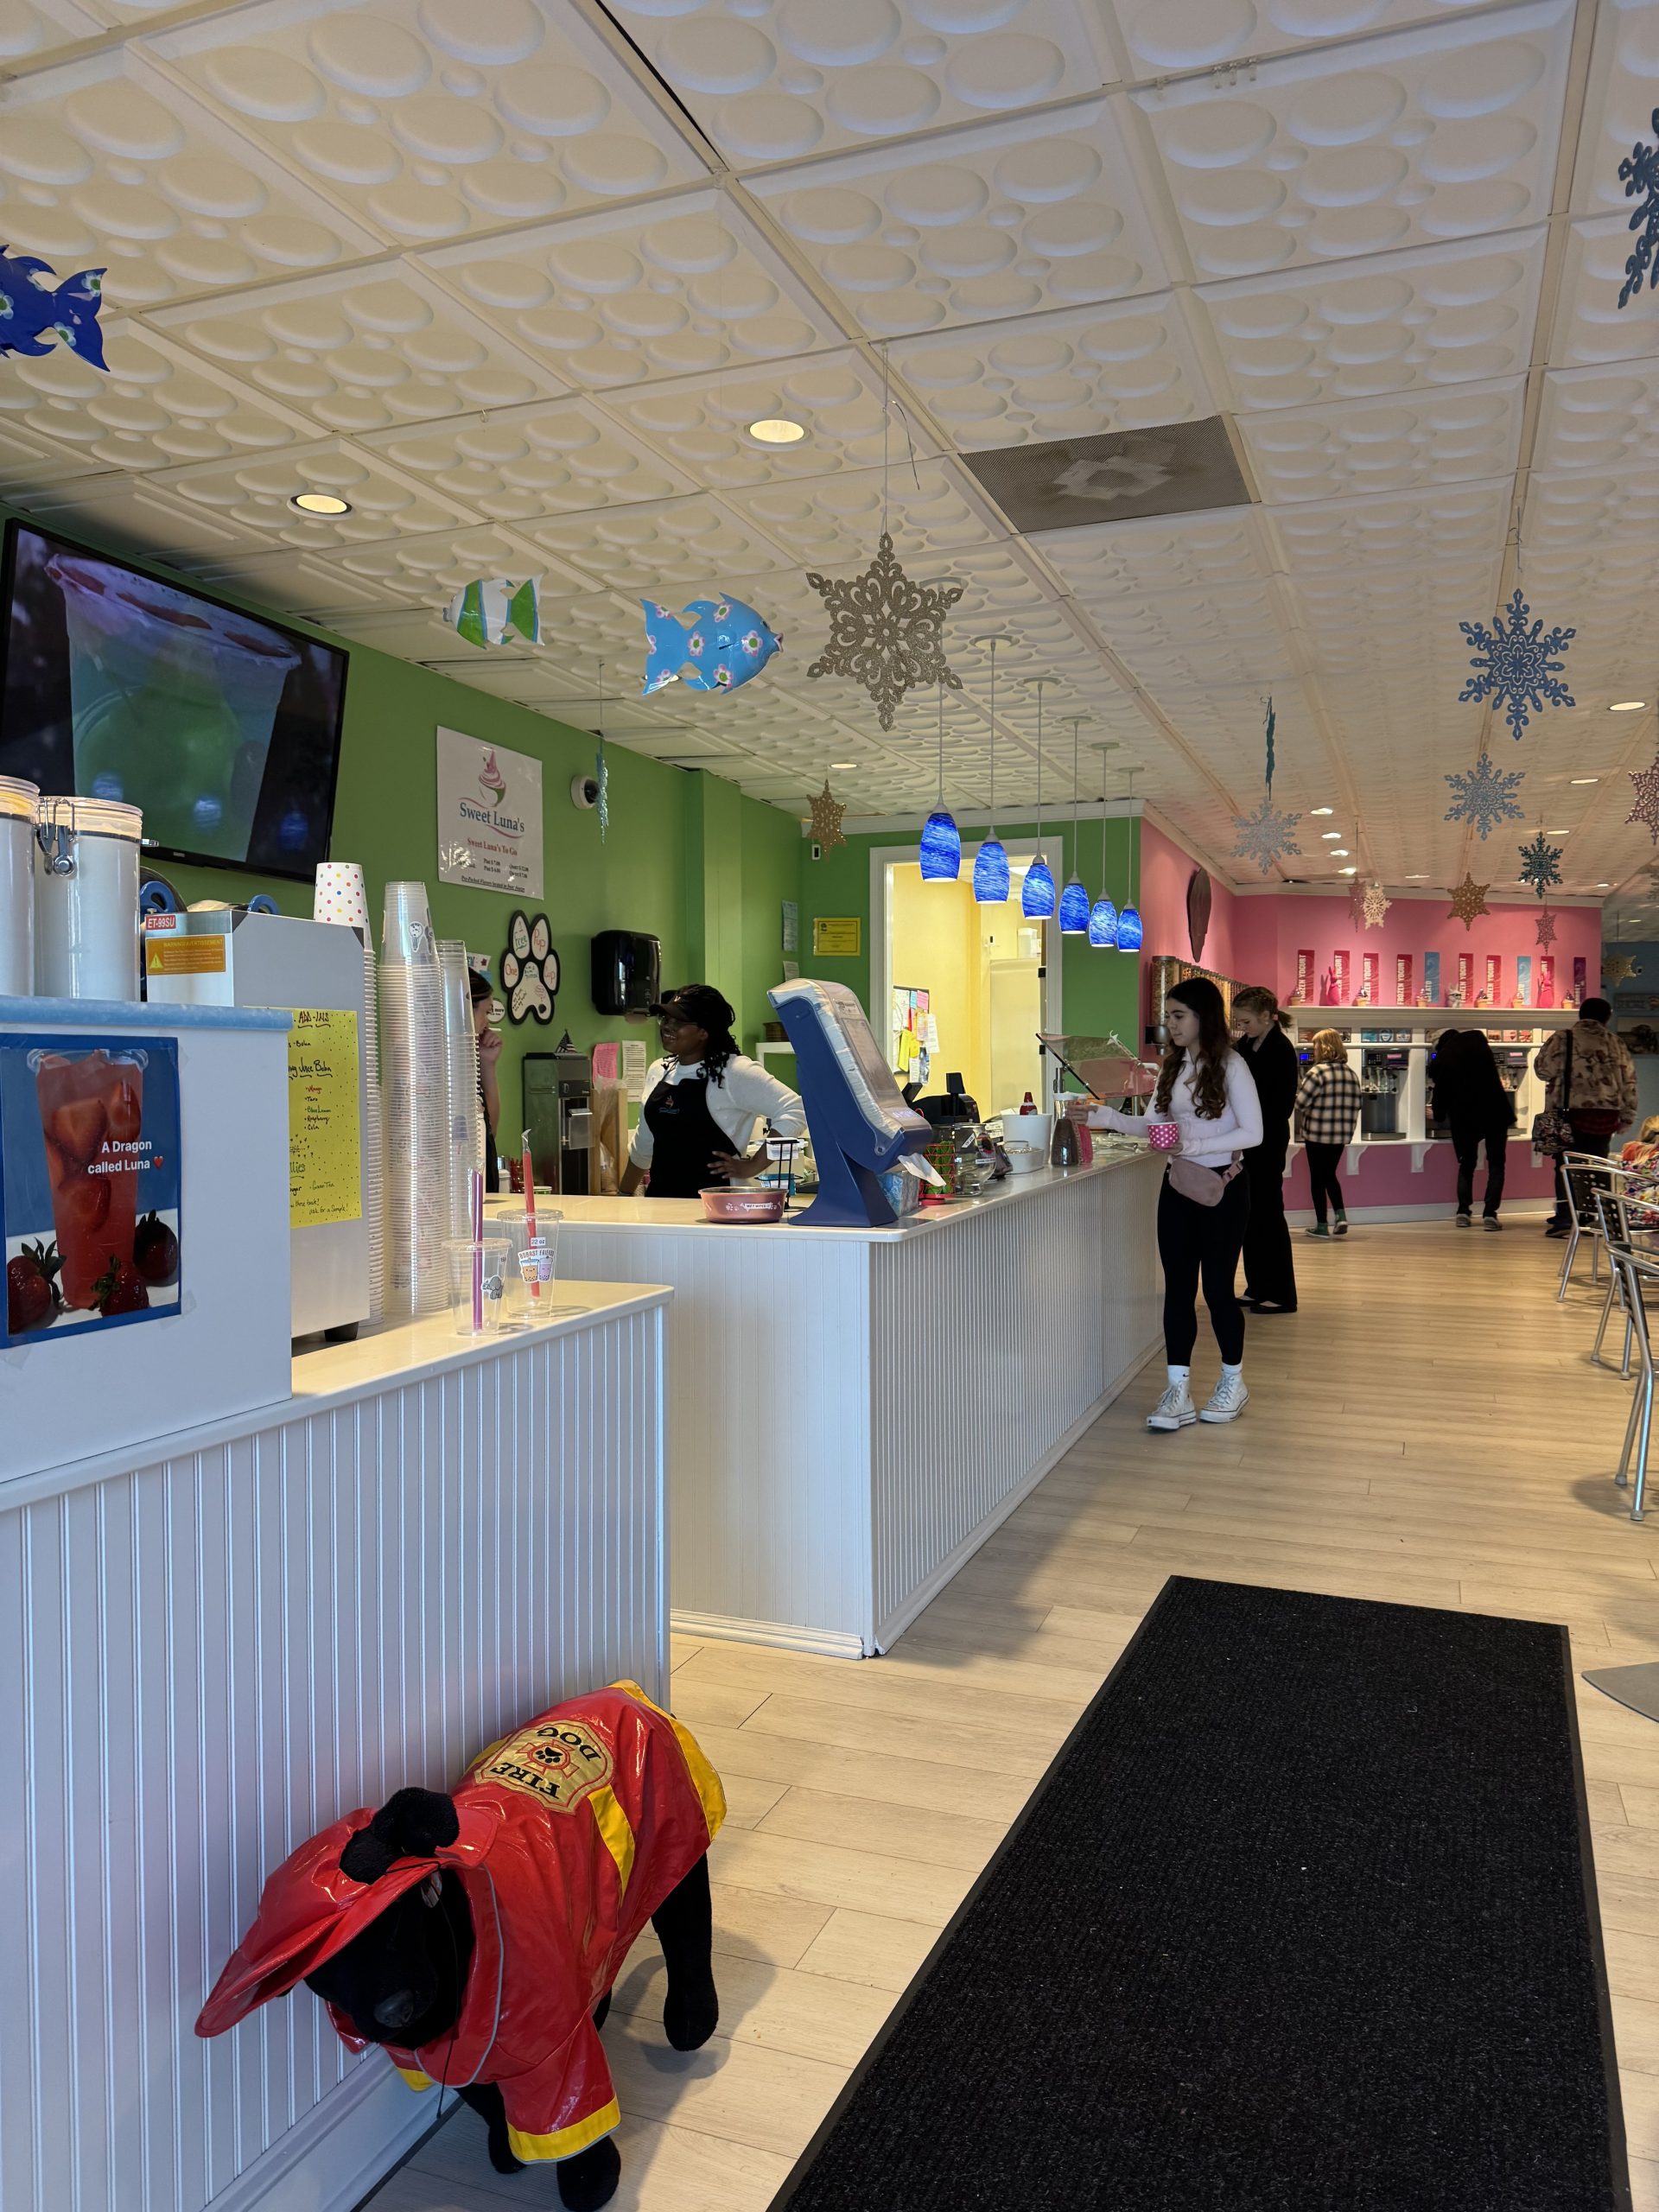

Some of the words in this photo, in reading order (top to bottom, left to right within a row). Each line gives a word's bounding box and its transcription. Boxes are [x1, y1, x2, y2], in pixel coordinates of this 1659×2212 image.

[460, 802, 491, 823] Sweet
[493, 810, 524, 832] Luna's
[467, 837, 482, 849] Sweet
[484, 841, 501, 853] Luna's
[502, 845, 508, 854] To
[509, 846, 518, 856] Go
[148, 918, 175, 928] ET-99SU
[534, 928, 545, 951] Pup
[505, 963, 518, 976] One
[314, 1059, 332, 1072] Boba
[102, 1141, 111, 1154] A
[112, 1141, 152, 1154] Dragon
[87, 1160, 122, 1174] called
[124, 1160, 150, 1171] Luna
[536, 1727, 601, 1762] DOG
[490, 1762, 560, 1799] FIRE
